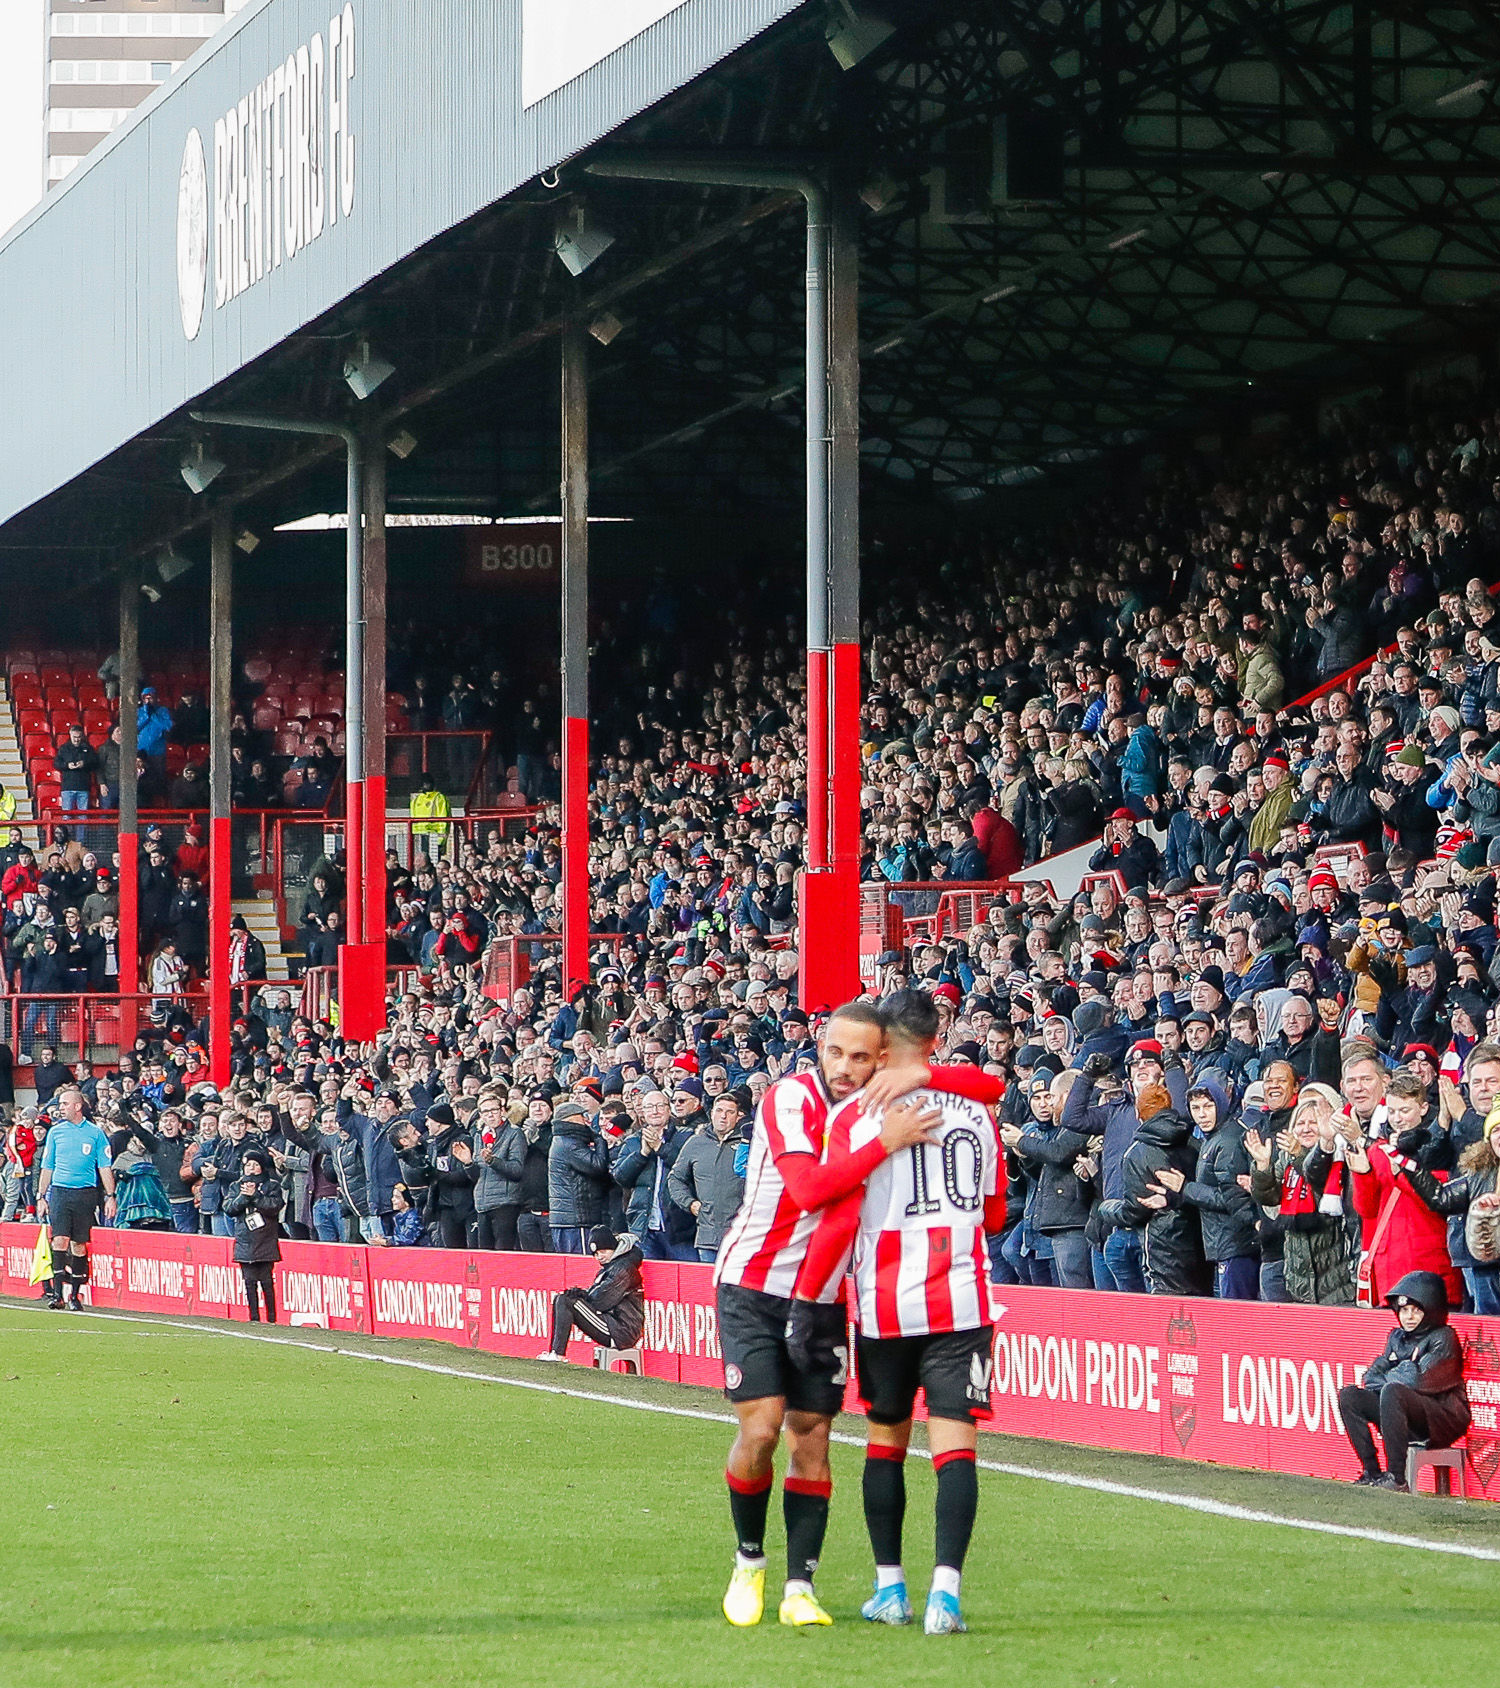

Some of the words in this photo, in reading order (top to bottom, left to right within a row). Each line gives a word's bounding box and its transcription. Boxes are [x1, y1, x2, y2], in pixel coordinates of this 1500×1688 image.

[214, 32, 325, 310] BRENTFORD
[330, 2, 355, 227] FC
[481, 543, 553, 571] B300
[905, 1128, 982, 1217] 10
[127, 1256, 160, 1295] LONDON
[160, 1260, 185, 1298] PRIDE
[198, 1263, 236, 1305] LONDON
[282, 1270, 322, 1313] LONDON
[322, 1274, 352, 1318] PRIDE
[373, 1279, 425, 1326] LONDON
[425, 1282, 465, 1330] PRIDE
[491, 1286, 548, 1338] LONDON
[635, 1299, 691, 1356] NDON
[990, 1331, 1078, 1403] ONDON
[1084, 1339, 1161, 1413] PRIDE
[1222, 1352, 1346, 1436] LONDON
